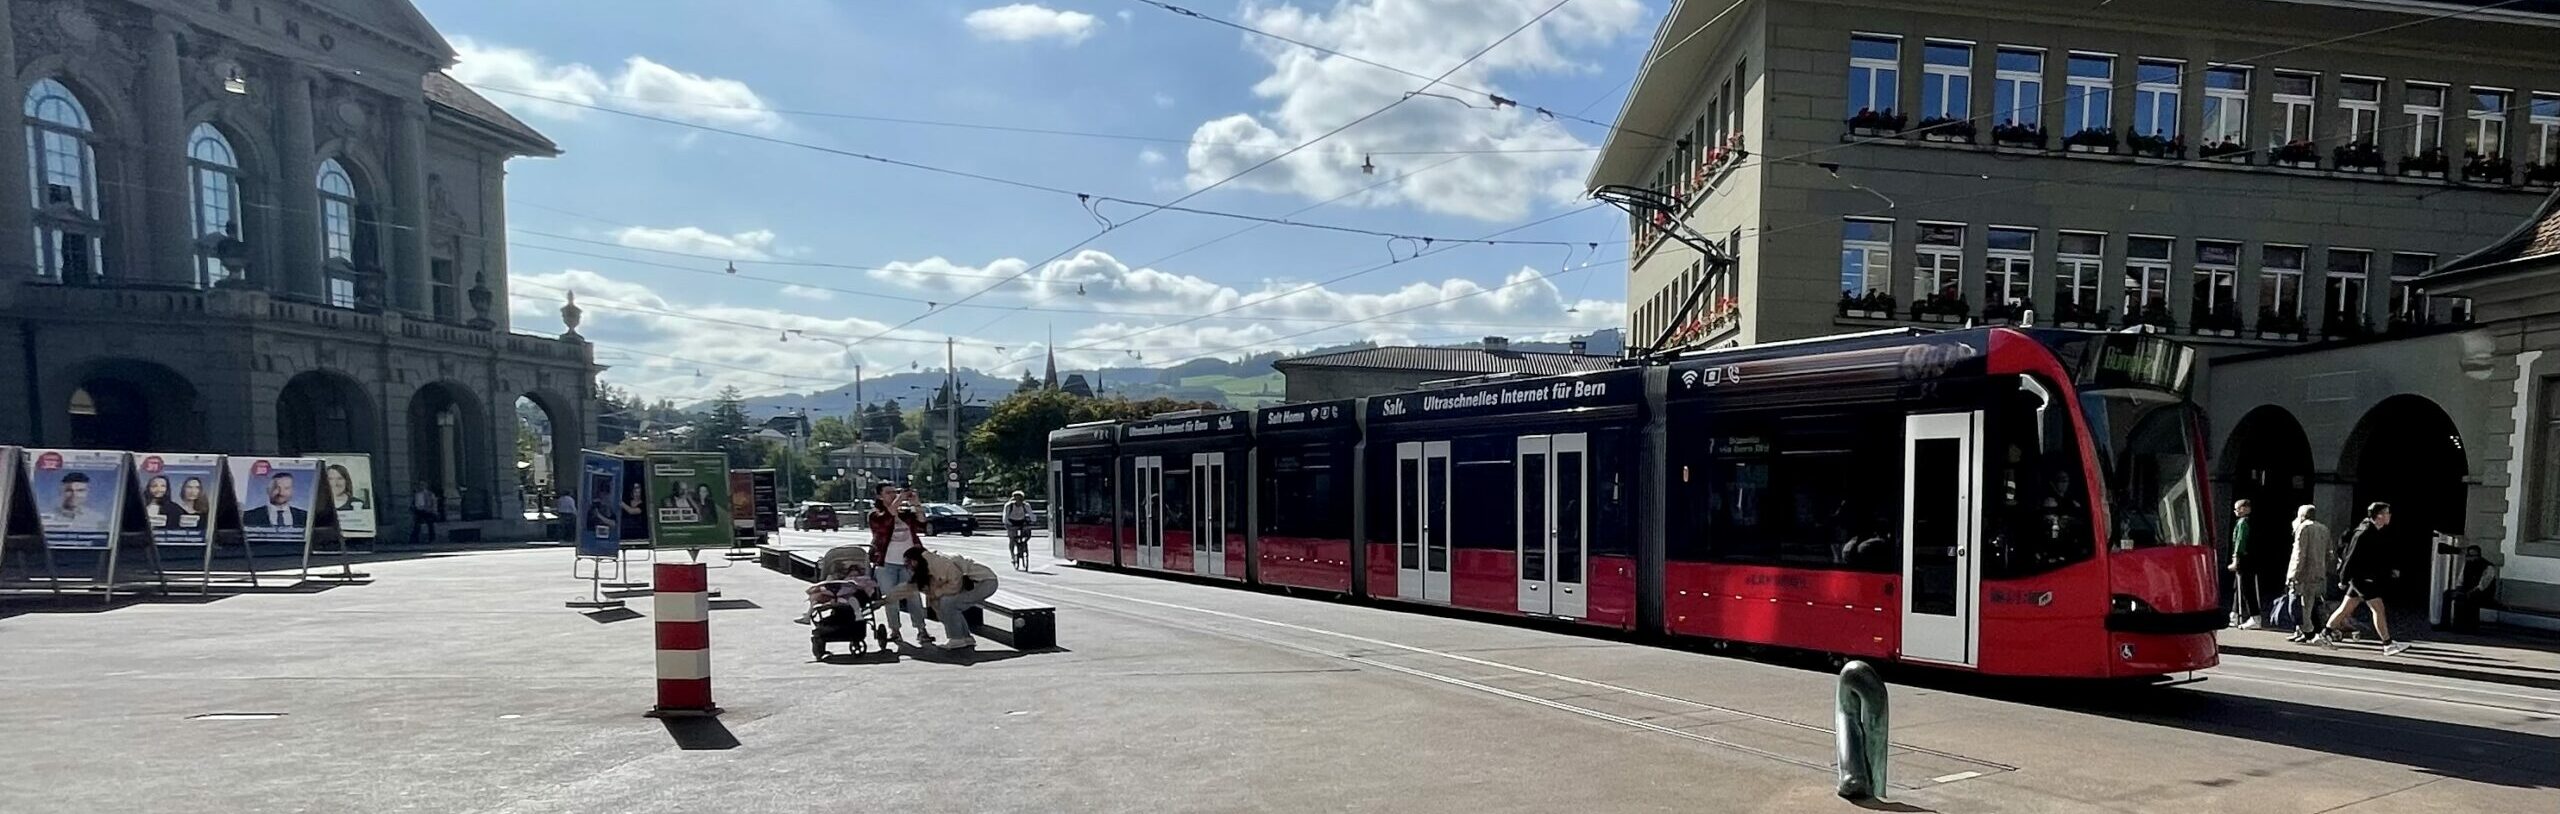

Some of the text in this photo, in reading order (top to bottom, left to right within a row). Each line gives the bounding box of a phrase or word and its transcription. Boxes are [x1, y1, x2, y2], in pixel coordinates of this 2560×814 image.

[1423, 380, 1606, 412] Ultraschnelles Internet für Bern
[1383, 398, 1407, 417] Salt.
[1268, 411, 1283, 425] Salt
